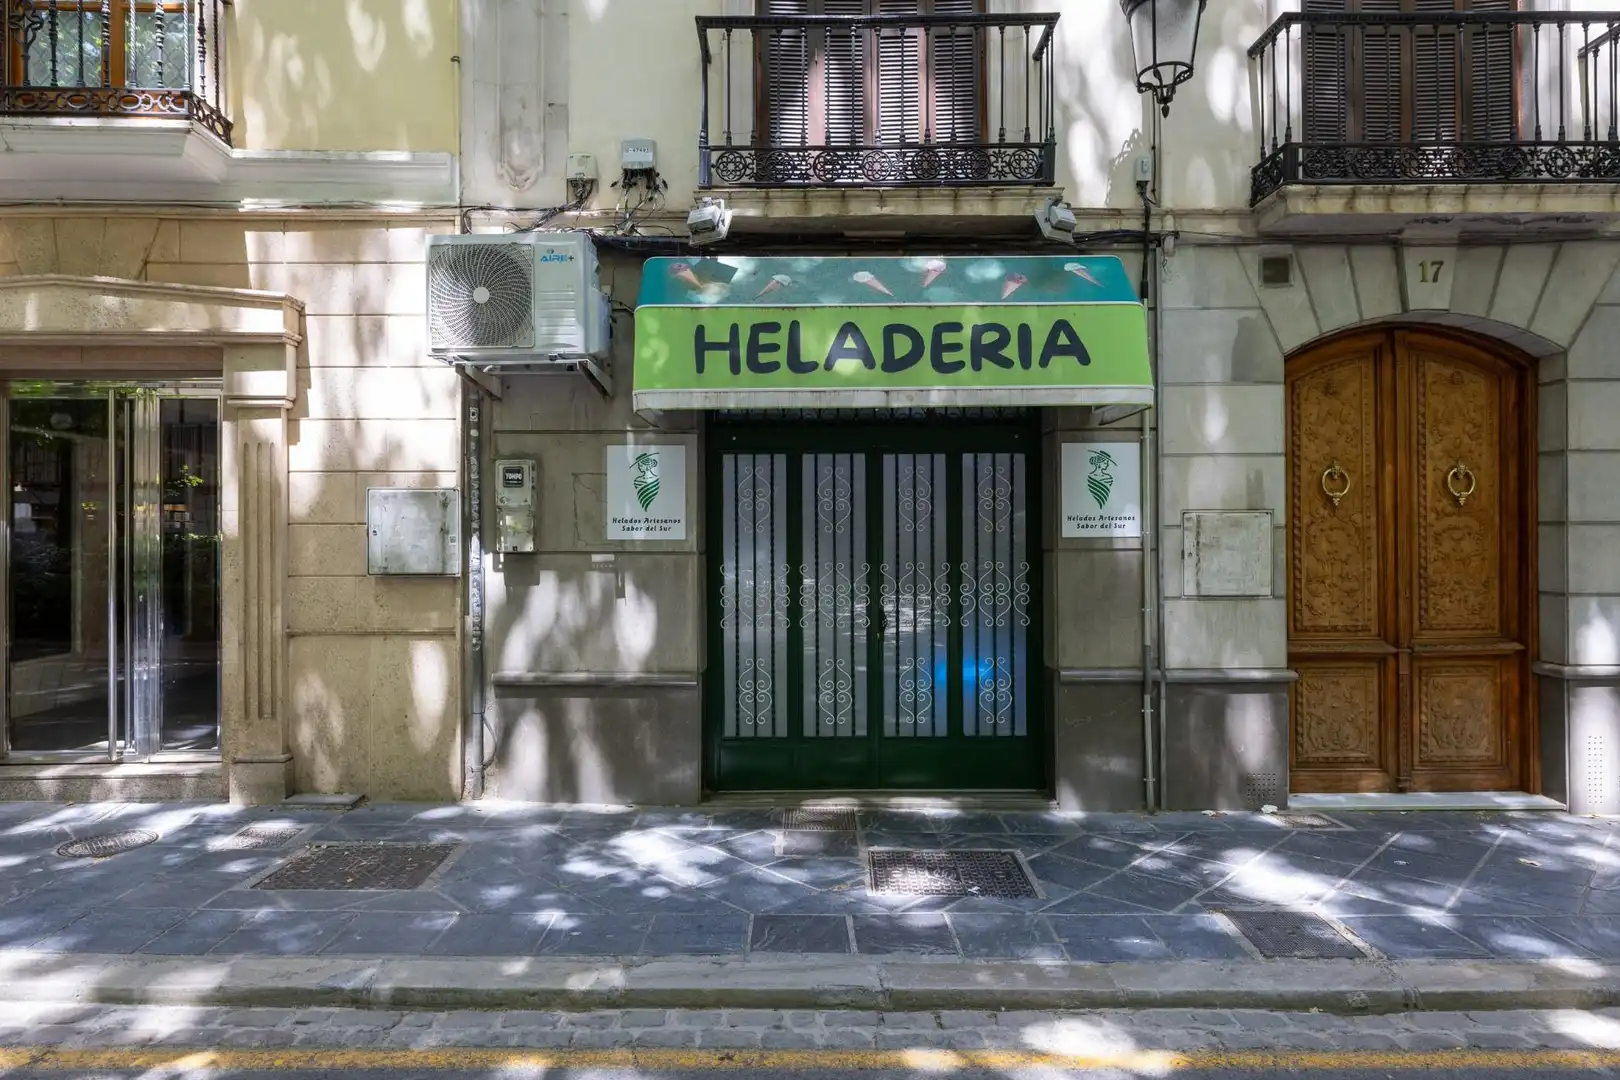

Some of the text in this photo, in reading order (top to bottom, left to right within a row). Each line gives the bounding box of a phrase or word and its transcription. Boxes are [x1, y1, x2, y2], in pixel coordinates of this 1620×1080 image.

[1418, 260, 1445, 283] 17
[693, 318, 1092, 376] HELADERIA
[621, 525, 643, 533] Sabor
[659, 525, 672, 533] Sur
[1076, 522, 1127, 530] Sabor del Sur
